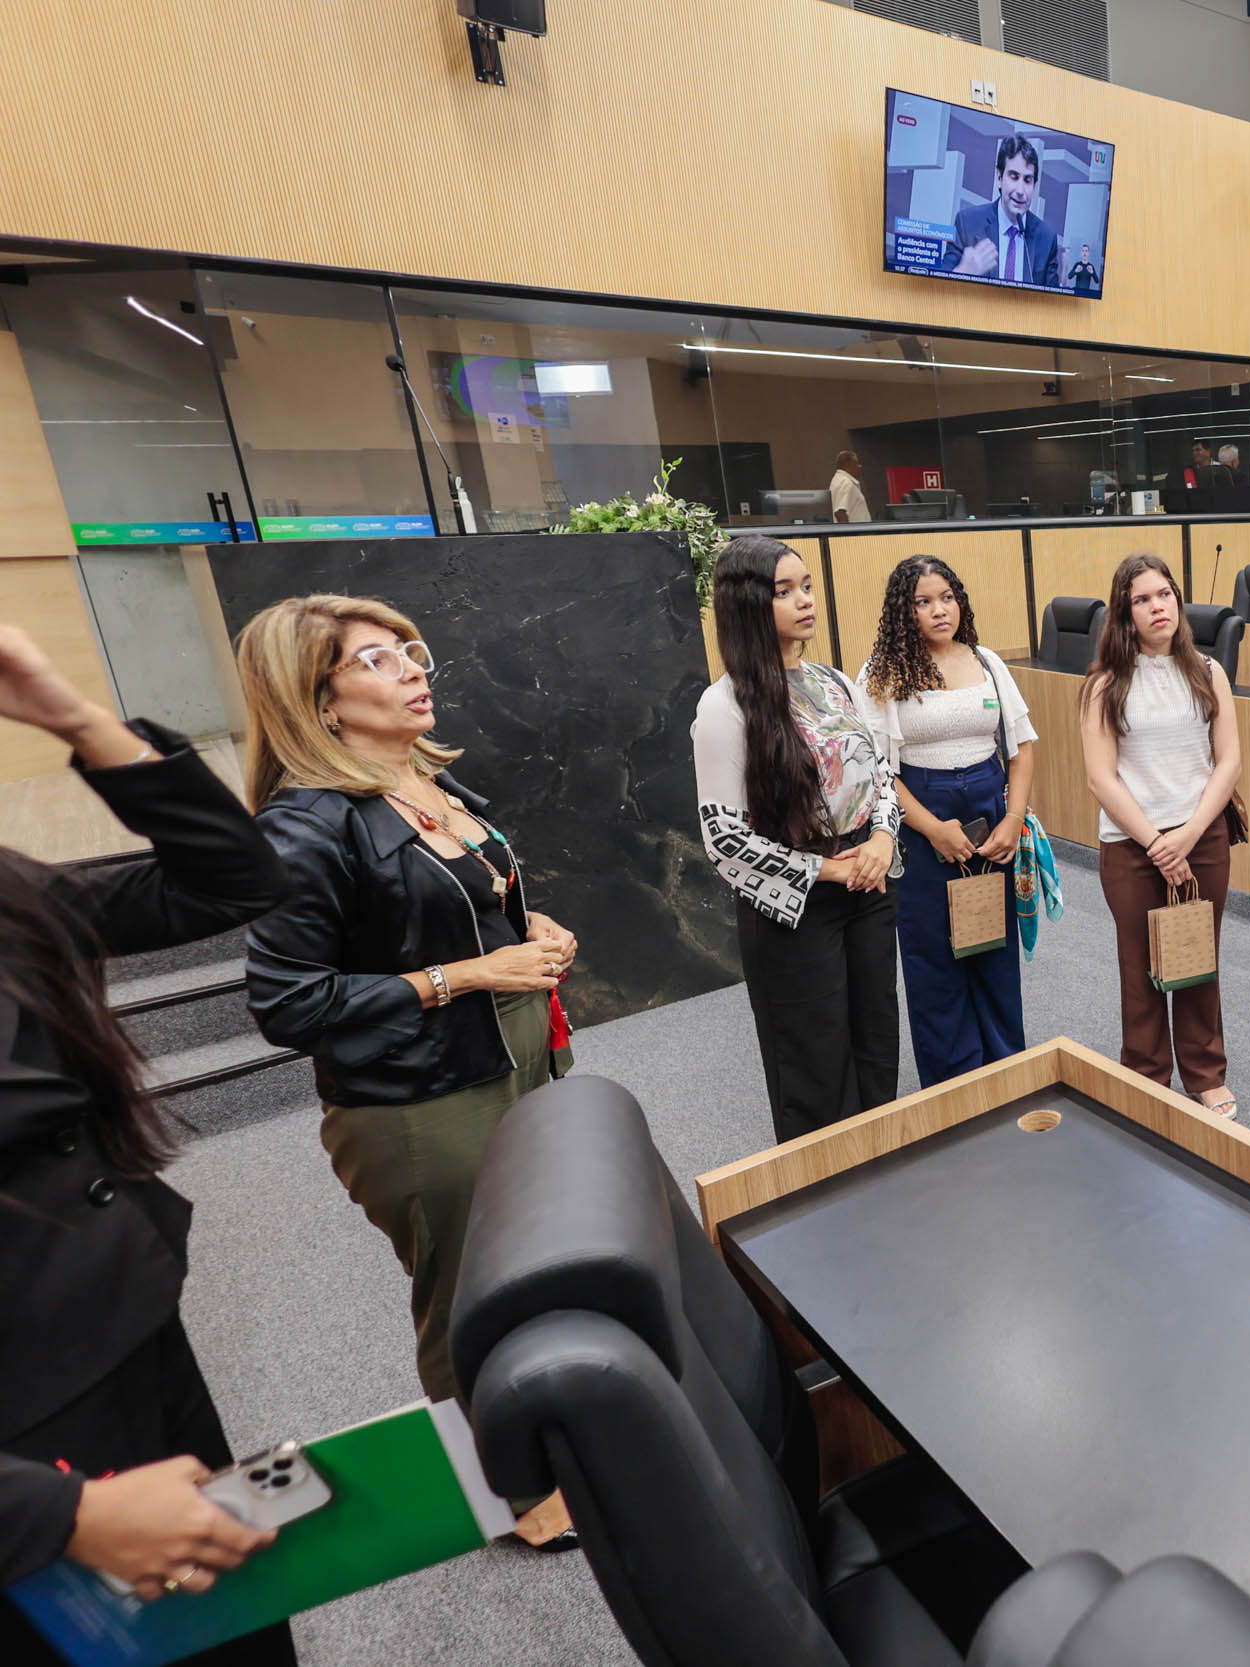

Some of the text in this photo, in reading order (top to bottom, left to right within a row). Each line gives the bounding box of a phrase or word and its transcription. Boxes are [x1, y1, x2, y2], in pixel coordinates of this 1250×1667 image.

[898, 236, 925, 248] Audiência
[902, 246, 931, 257] presidente
[897, 253, 936, 264] Banco Central
[927, 475, 936, 486] H
